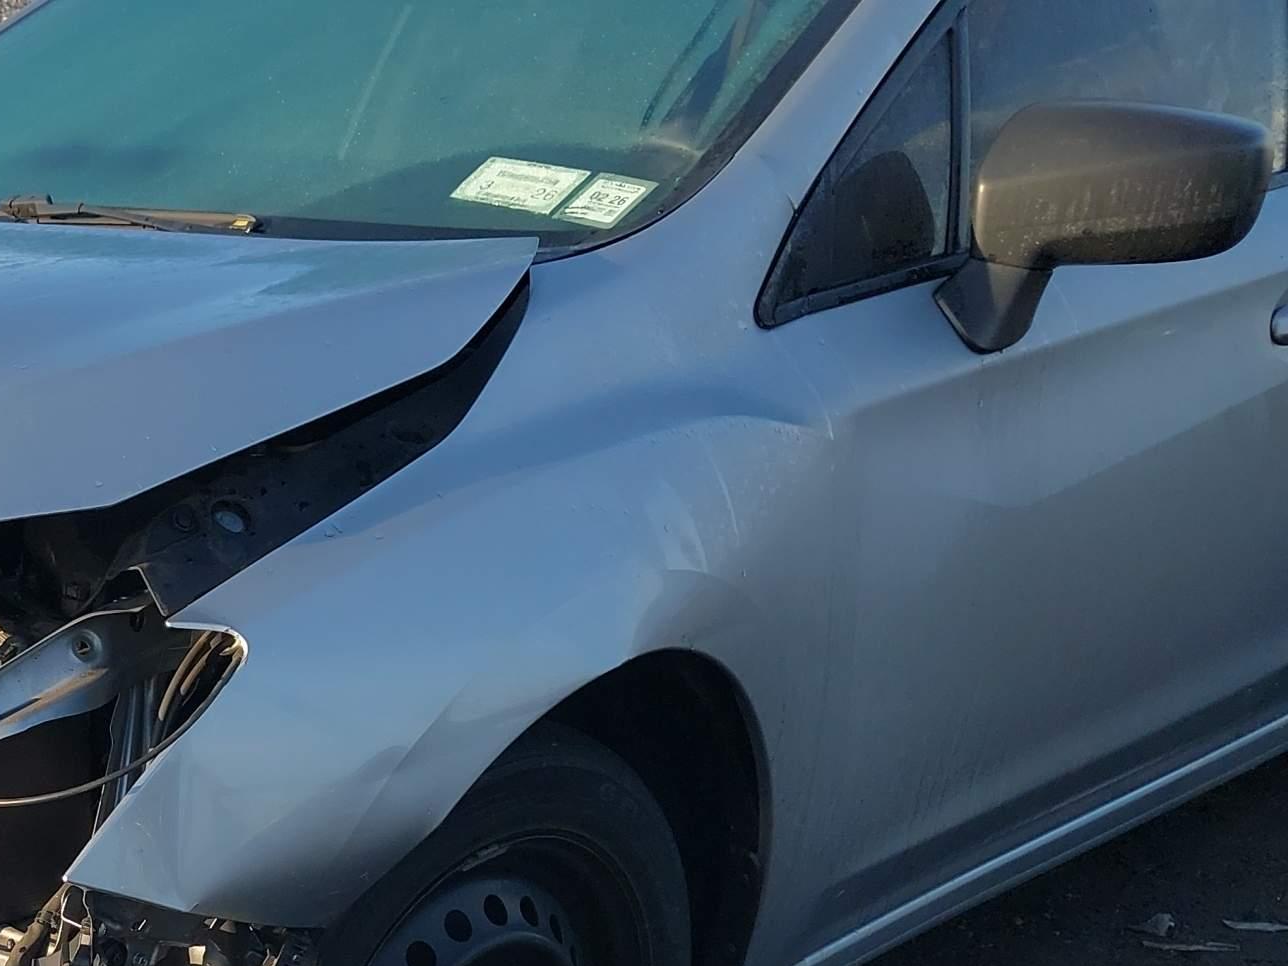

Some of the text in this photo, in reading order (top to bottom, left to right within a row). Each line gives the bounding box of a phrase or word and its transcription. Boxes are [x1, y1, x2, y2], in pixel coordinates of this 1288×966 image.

[479, 180, 494, 191] 3
[531, 187, 558, 202] 26
[589, 191, 630, 206] 02 26
